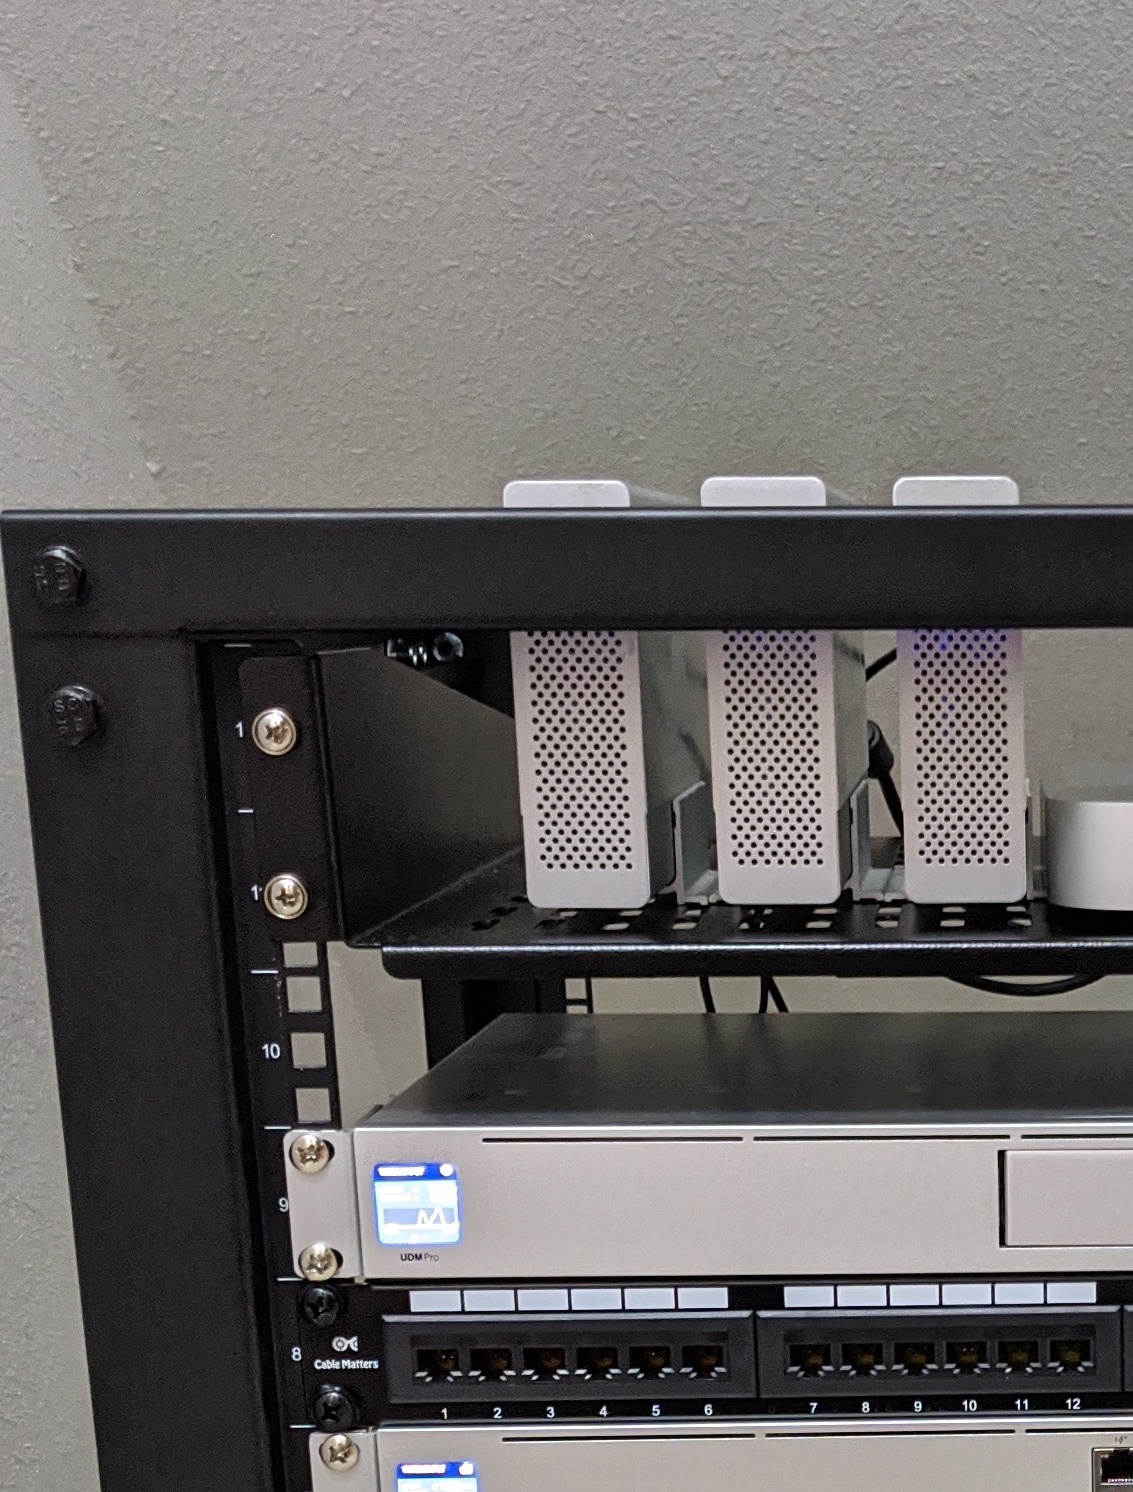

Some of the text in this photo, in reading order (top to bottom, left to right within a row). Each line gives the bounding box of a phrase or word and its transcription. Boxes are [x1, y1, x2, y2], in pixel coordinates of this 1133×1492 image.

[261, 1043, 281, 1059] 10
[278, 1197, 289, 1213] 9
[400, 1253, 440, 1261] UDM Pro
[291, 1346, 302, 1362] 8
[314, 1359, 379, 1370] Cable Matters
[704, 1403, 713, 1416] 6
[809, 1402, 818, 1413] 7
[861, 1401, 870, 1413] 8
[913, 1401, 922, 1412] 9
[962, 1399, 977, 1412] 10
[1015, 1398, 1029, 1411] 11
[1065, 1397, 1081, 1410] 12
[441, 1408, 448, 1420] 1
[493, 1407, 502, 1419] 2
[546, 1406, 555, 1418] 3
[598, 1405, 608, 1417] 4
[651, 1404, 661, 1417] 5
